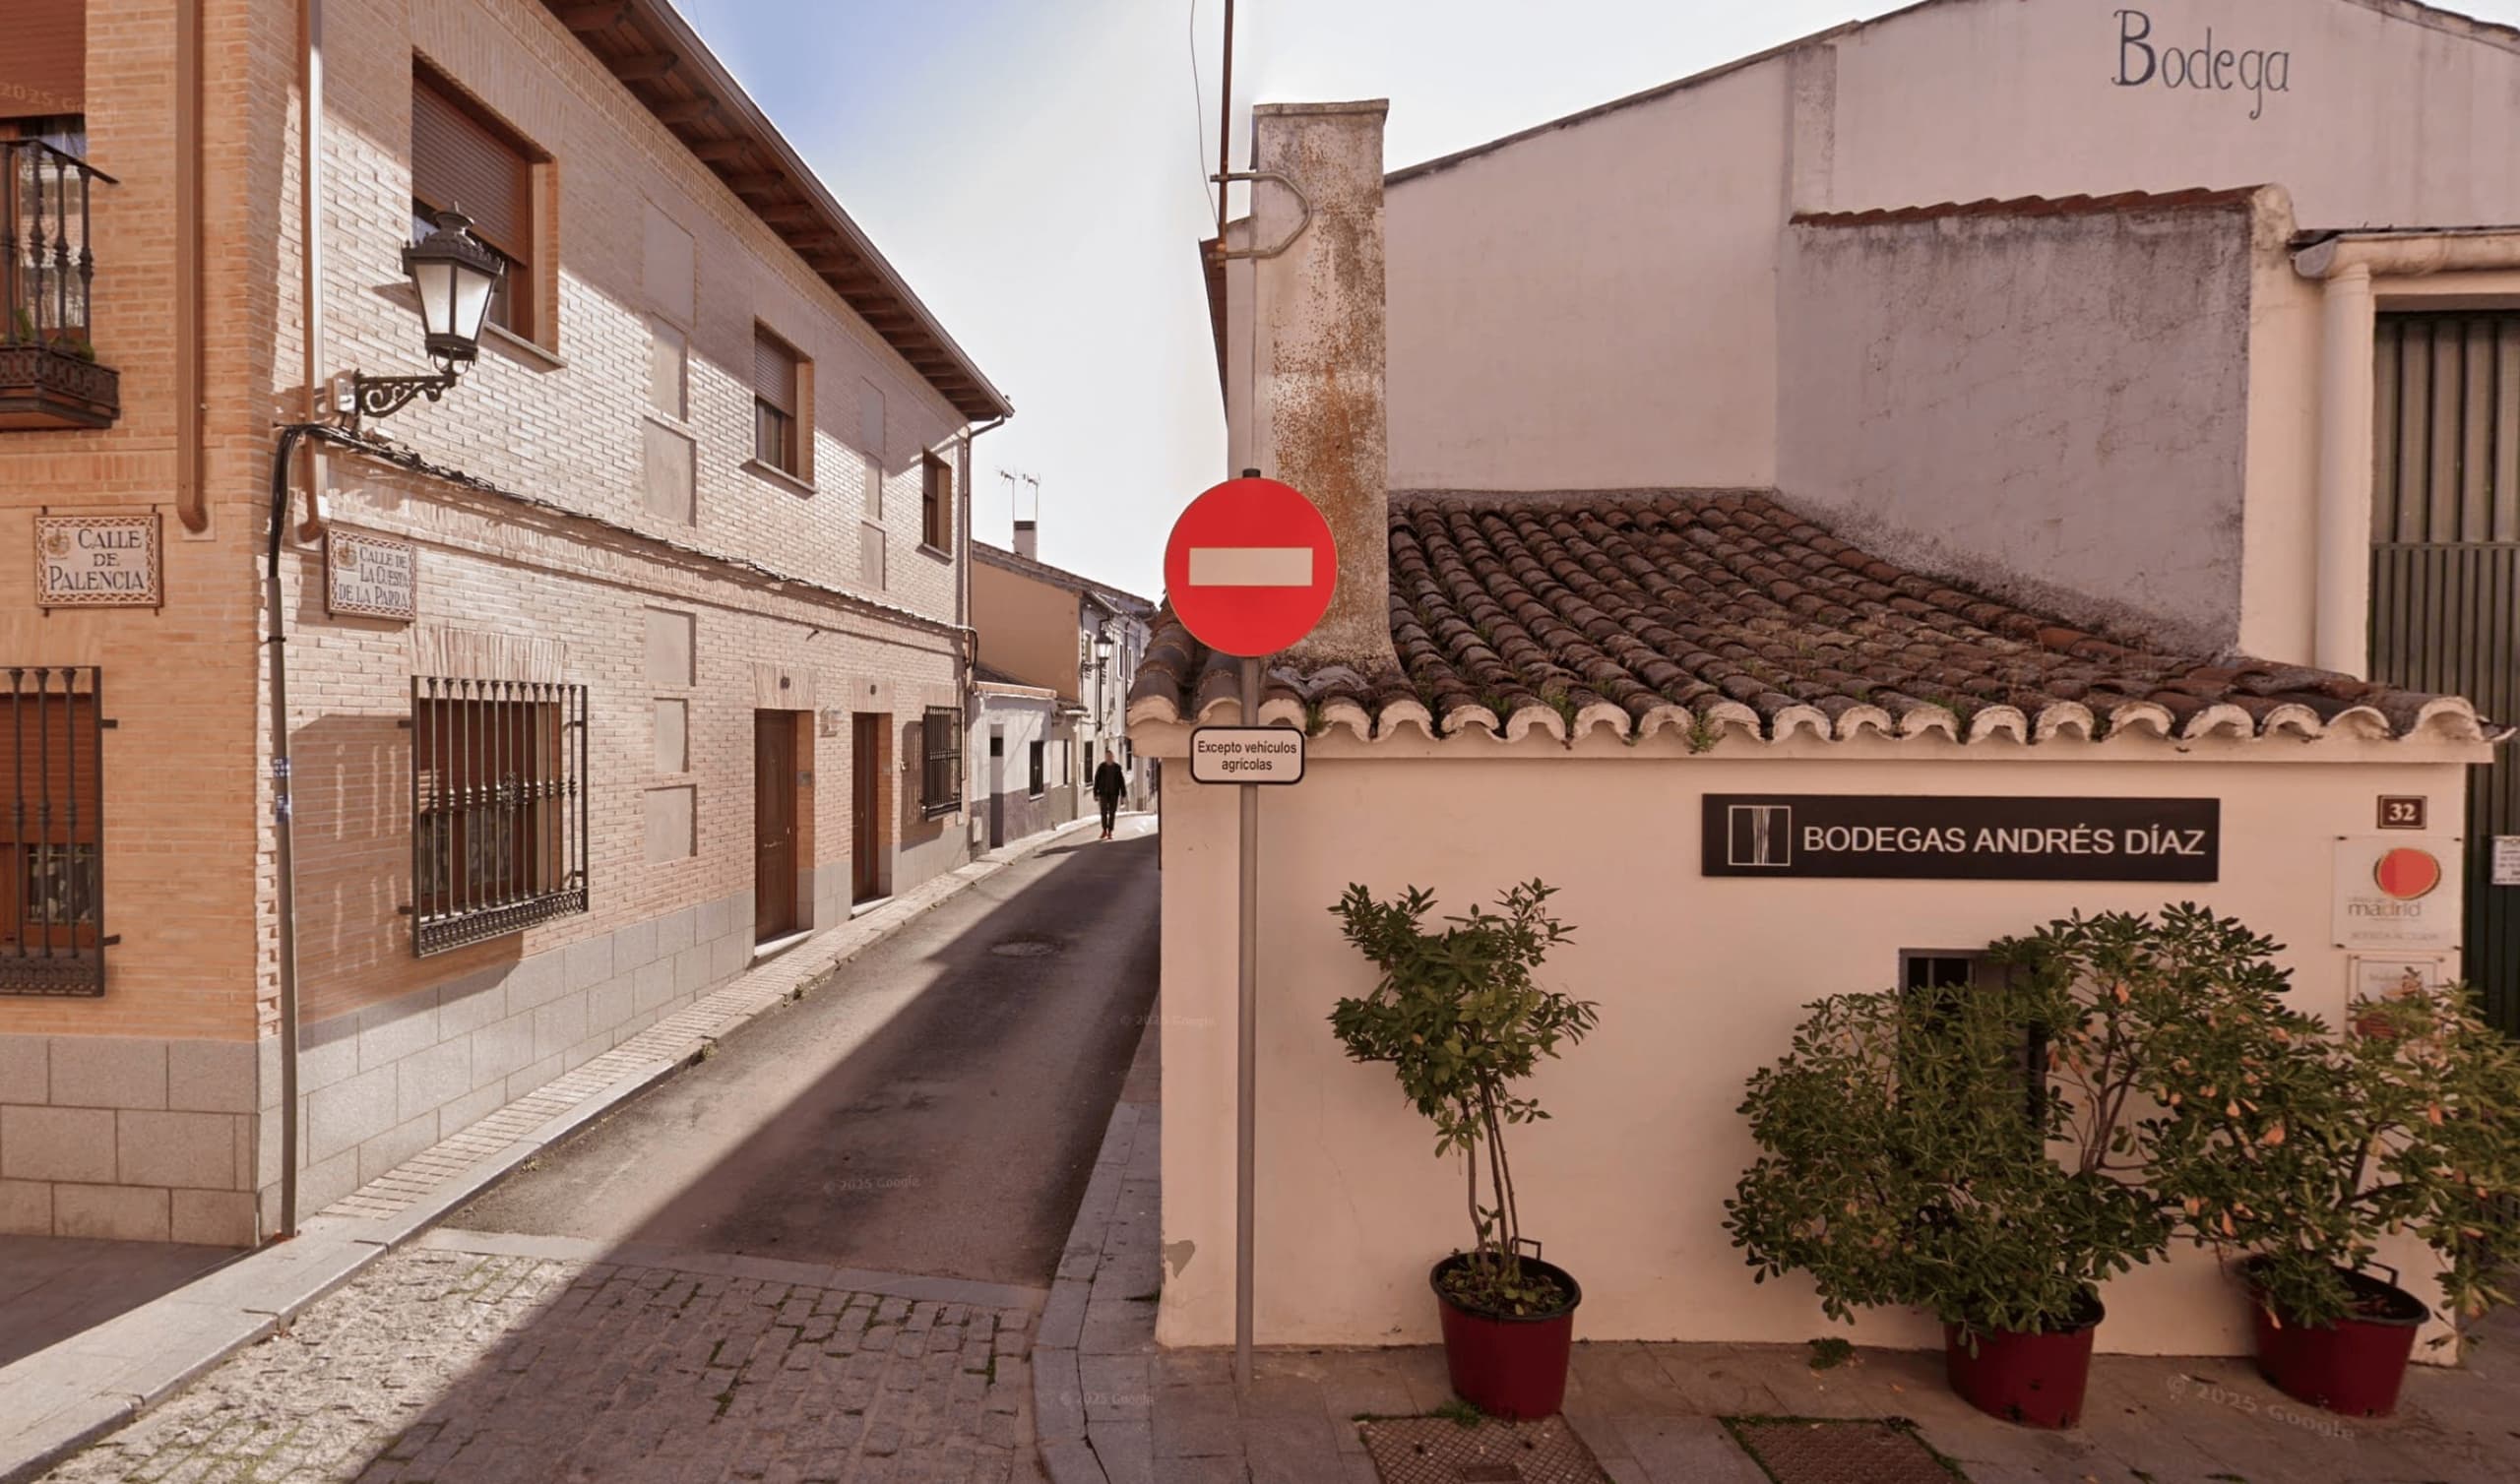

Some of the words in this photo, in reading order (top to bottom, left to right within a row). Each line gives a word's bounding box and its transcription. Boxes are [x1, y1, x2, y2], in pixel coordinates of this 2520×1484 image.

[2110, 9, 2290, 120] Bodega
[78, 527, 143, 549] CALLE
[93, 553, 120, 567] DE
[360, 547, 392, 566] CALLE
[396, 555, 409, 568] DE
[48, 565, 145, 590] PALENCIA
[360, 564, 374, 583] LA
[339, 584, 352, 601] DE
[356, 587, 371, 603] LA
[375, 586, 408, 607] PARRA
[1197, 740, 1242, 756] Excepto
[1244, 740, 1297, 754] vehículos
[1221, 758, 1273, 773] agrícolas
[2388, 803, 2416, 822] 32
[1802, 826, 1967, 853] BODEGAS
[1972, 823, 2115, 855] ANDRÉS
[2123, 824, 2206, 855] DÍAZ
[2348, 901, 2422, 917] madrid
